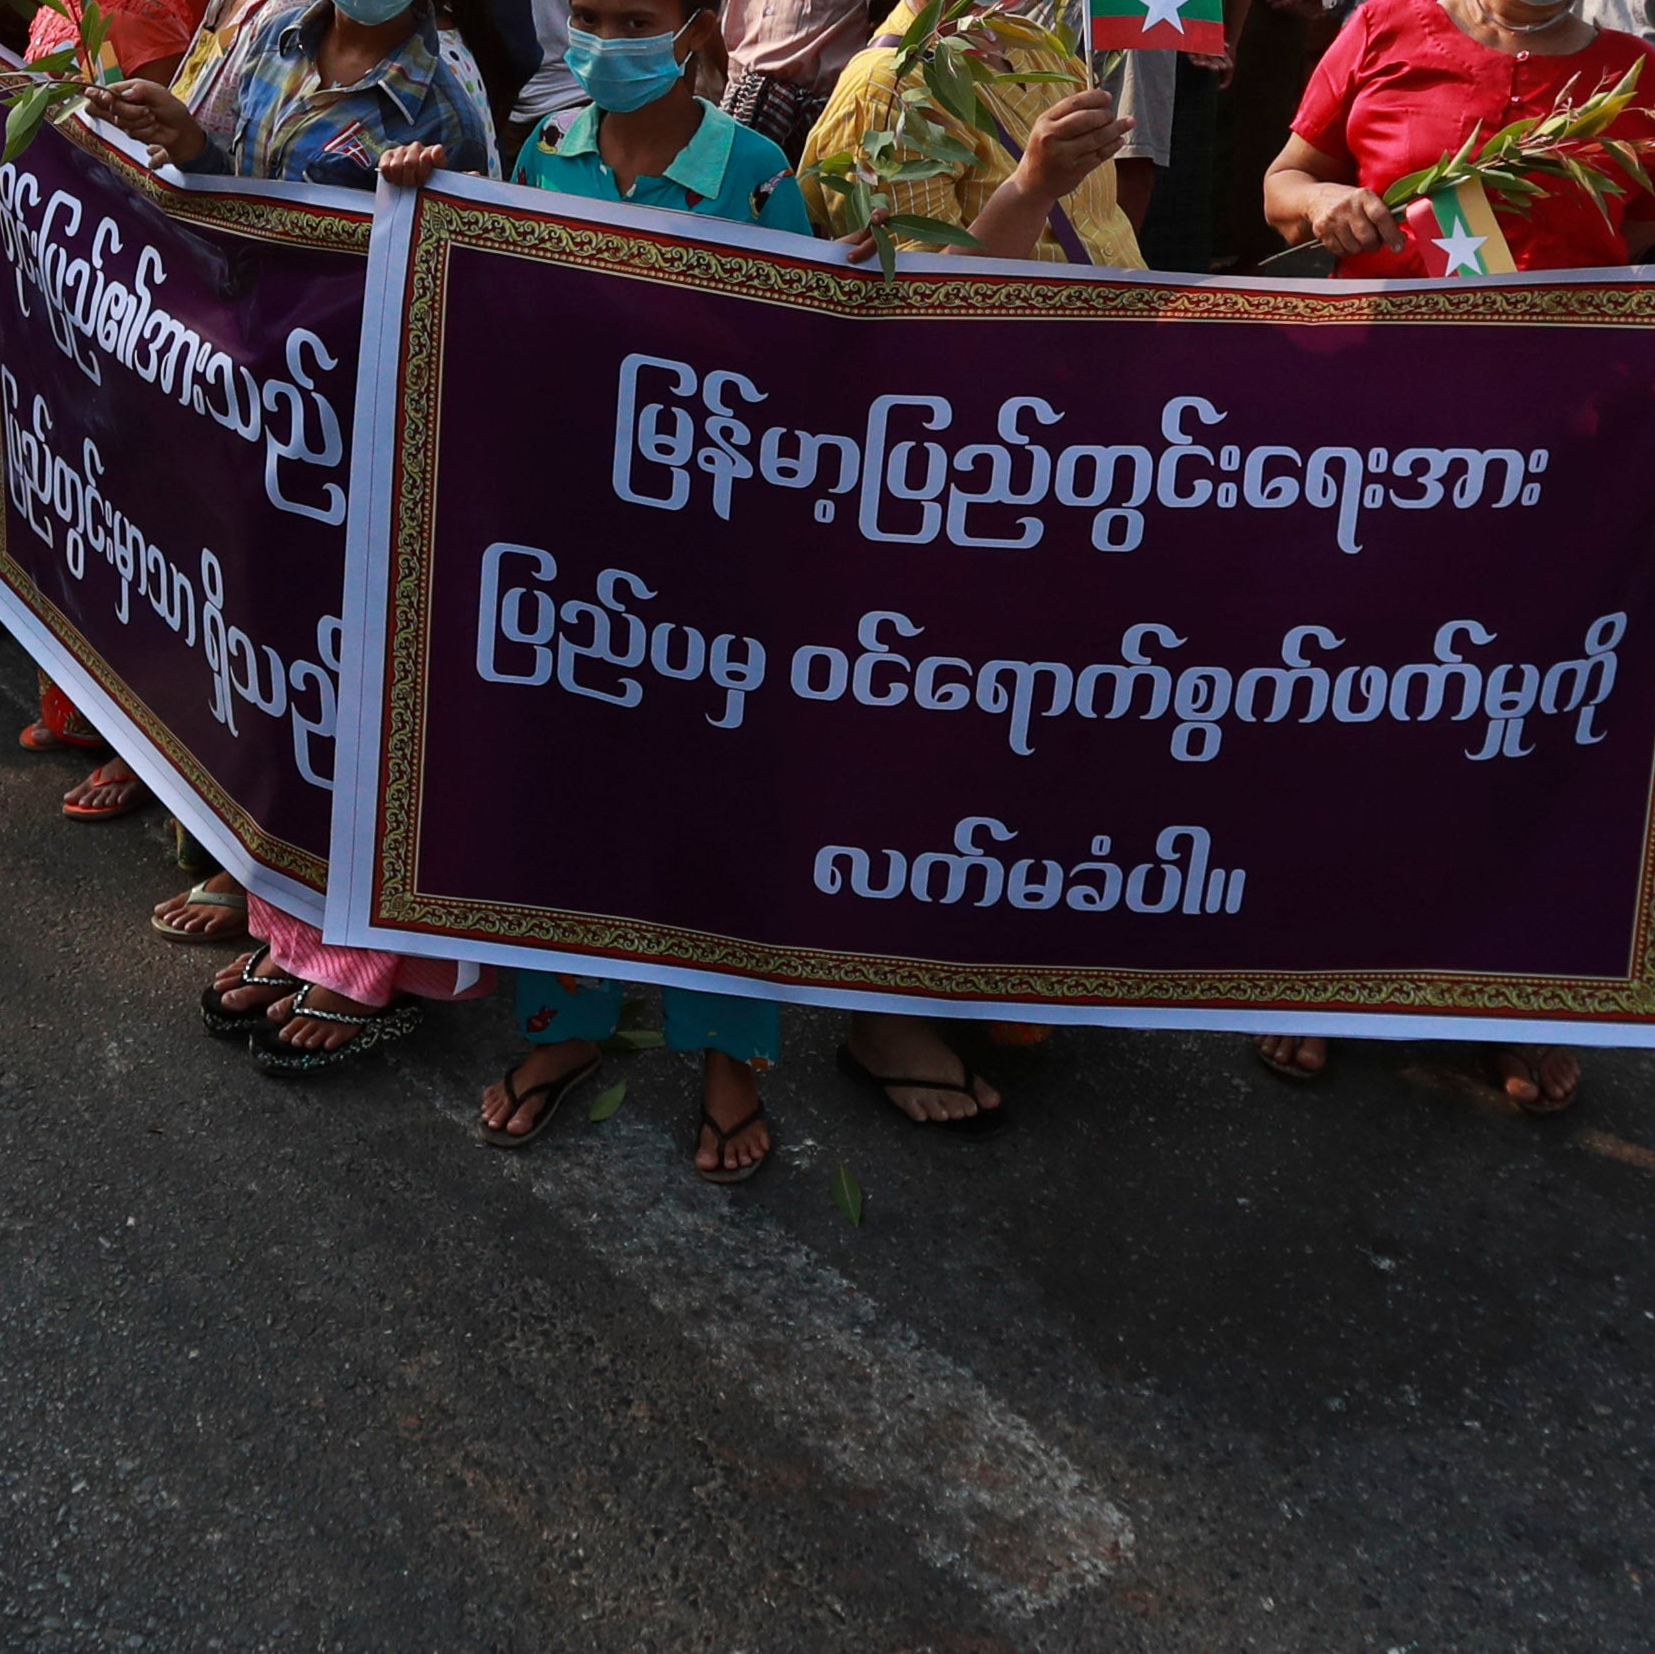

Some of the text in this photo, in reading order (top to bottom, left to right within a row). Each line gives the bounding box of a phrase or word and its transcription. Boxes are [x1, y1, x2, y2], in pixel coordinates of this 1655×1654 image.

[611, 352, 1548, 553] မြန်မာ့ပြည်တွင်းရေးအား
[476, 542, 1627, 762] ပြည်ပမှ ဝင်ရောက်စွက်ဖက်မှုကို
[814, 816, 1245, 916] လက်မခံပါ။
